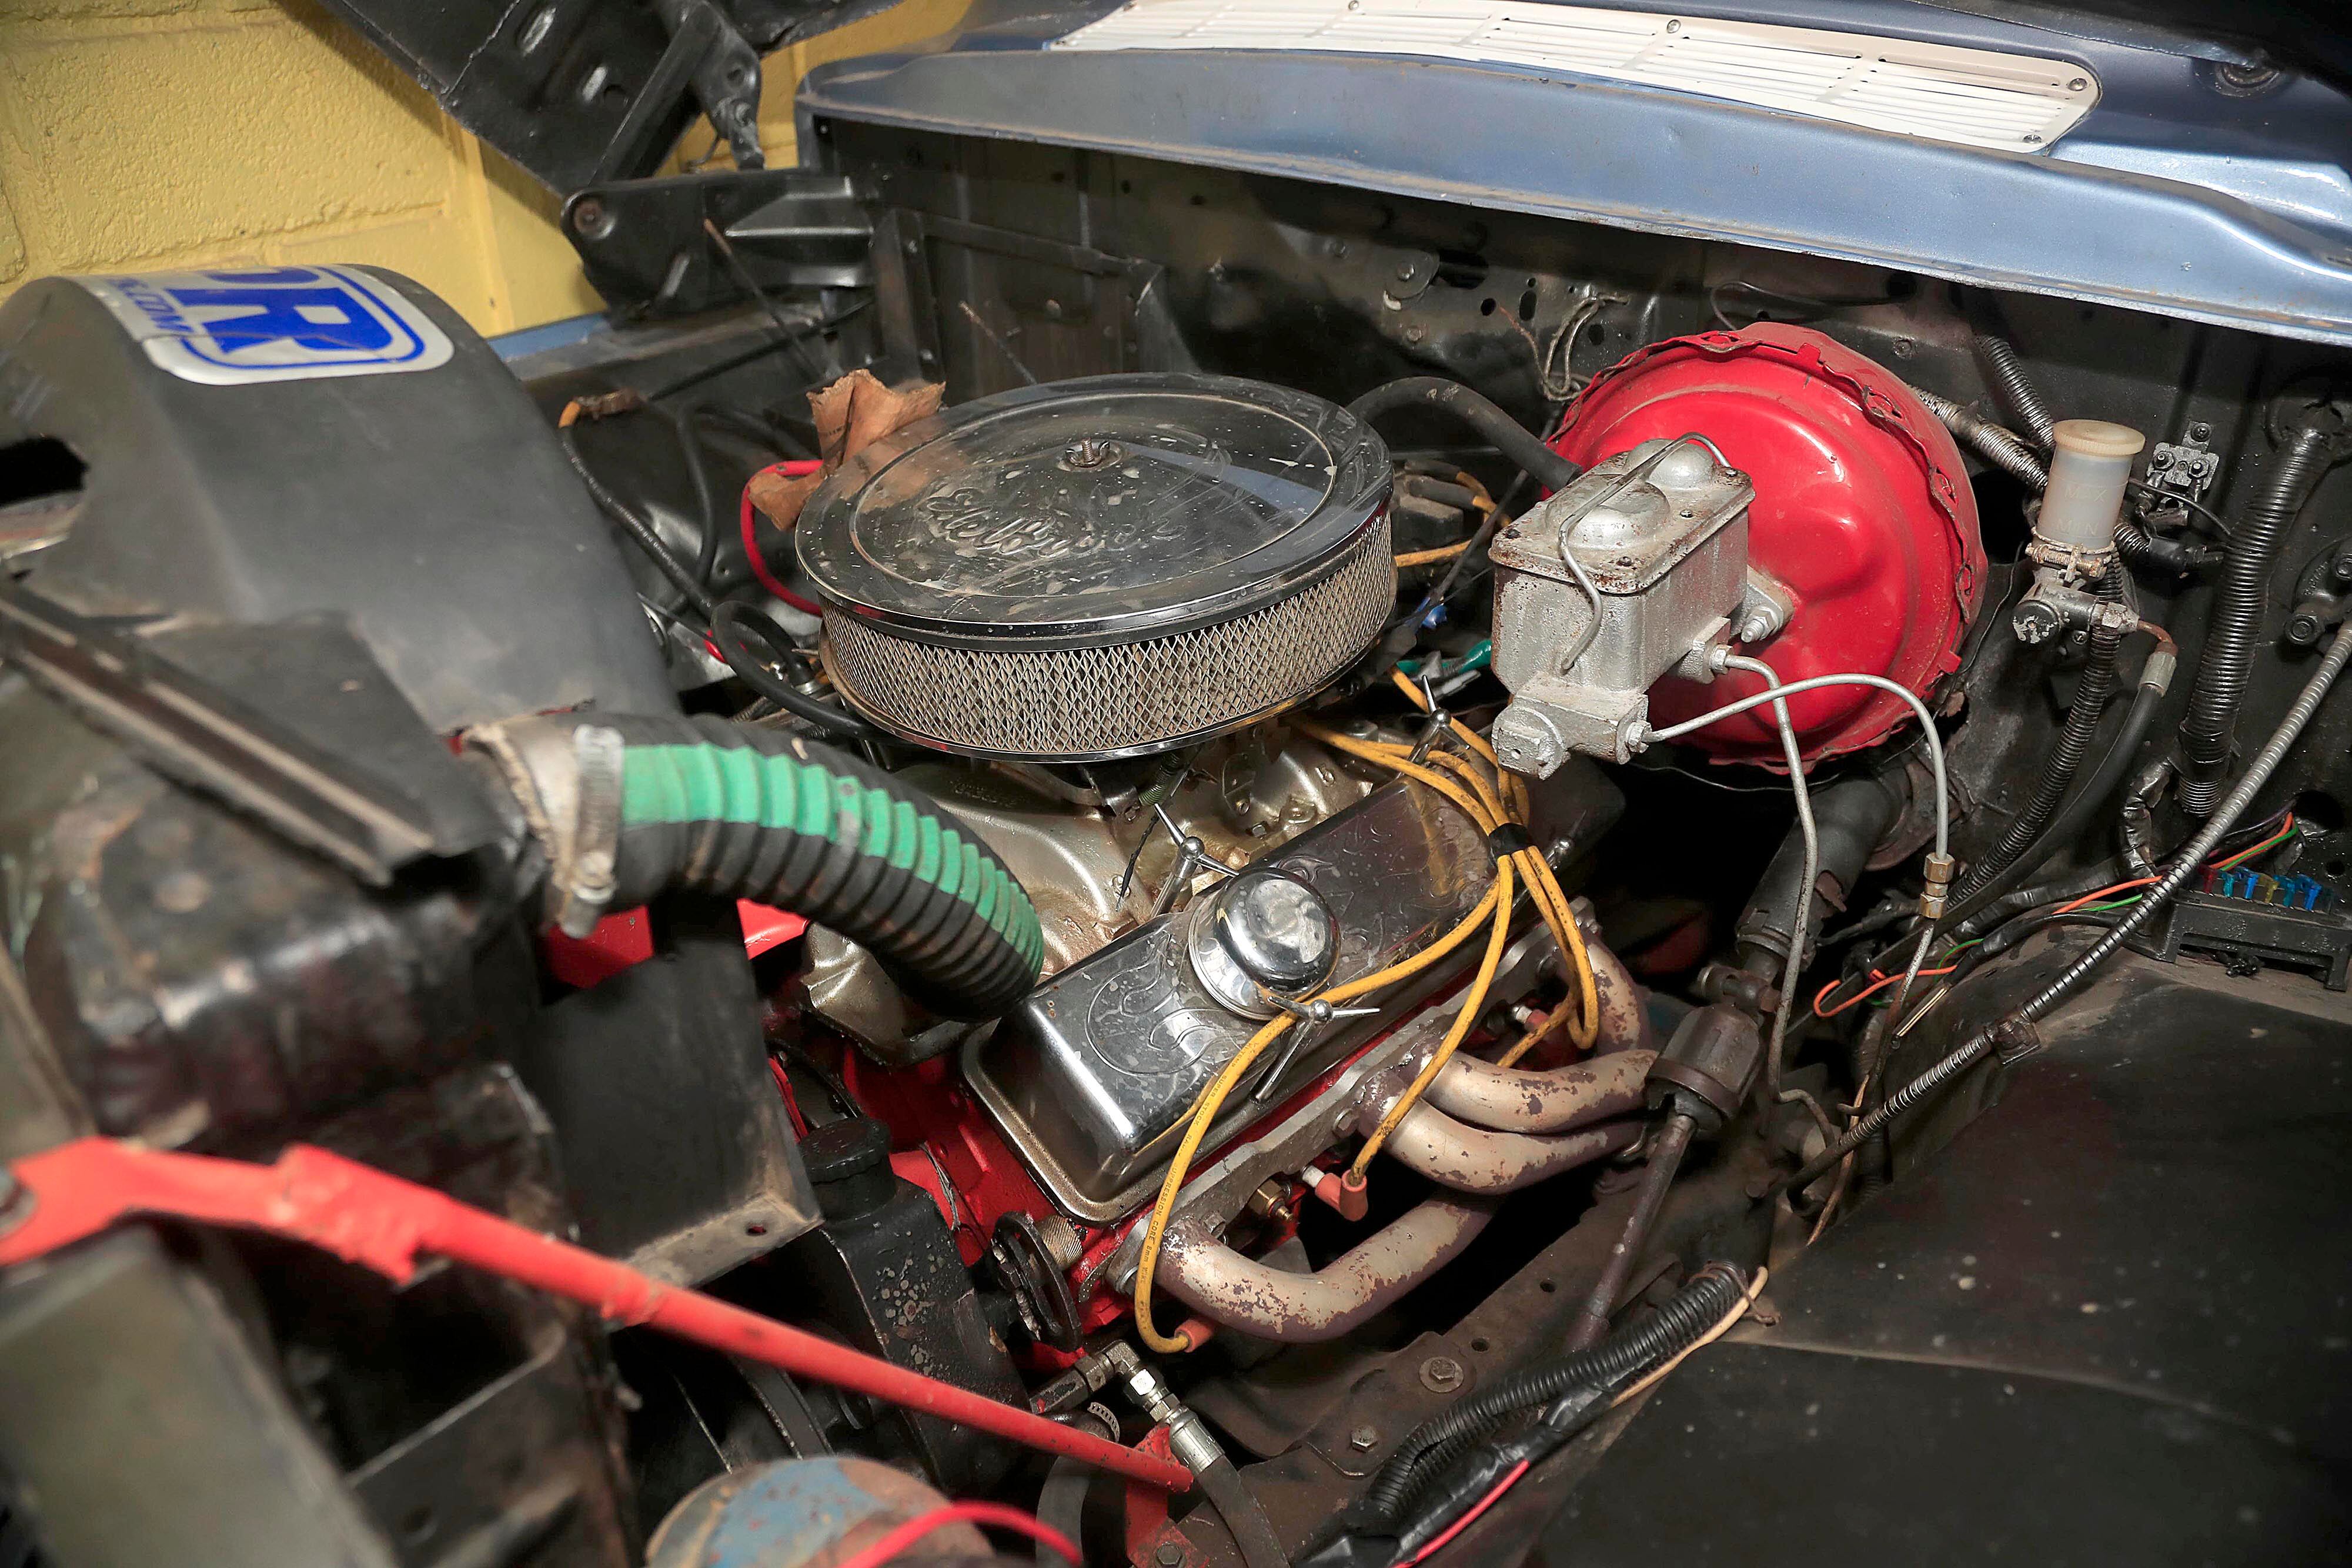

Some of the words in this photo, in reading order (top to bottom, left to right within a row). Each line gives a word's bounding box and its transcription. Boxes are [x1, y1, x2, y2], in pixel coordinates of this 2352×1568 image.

[1534, 861, 1544, 877] WIRE
[1211, 1075, 1227, 1098] SUPER
[1193, 1102, 1210, 1126] STOCK
[1156, 1162, 1178, 1216] UPPRESSION
[1148, 1219, 1159, 1242] CORE
[1143, 1245, 1152, 1263] 8mm
